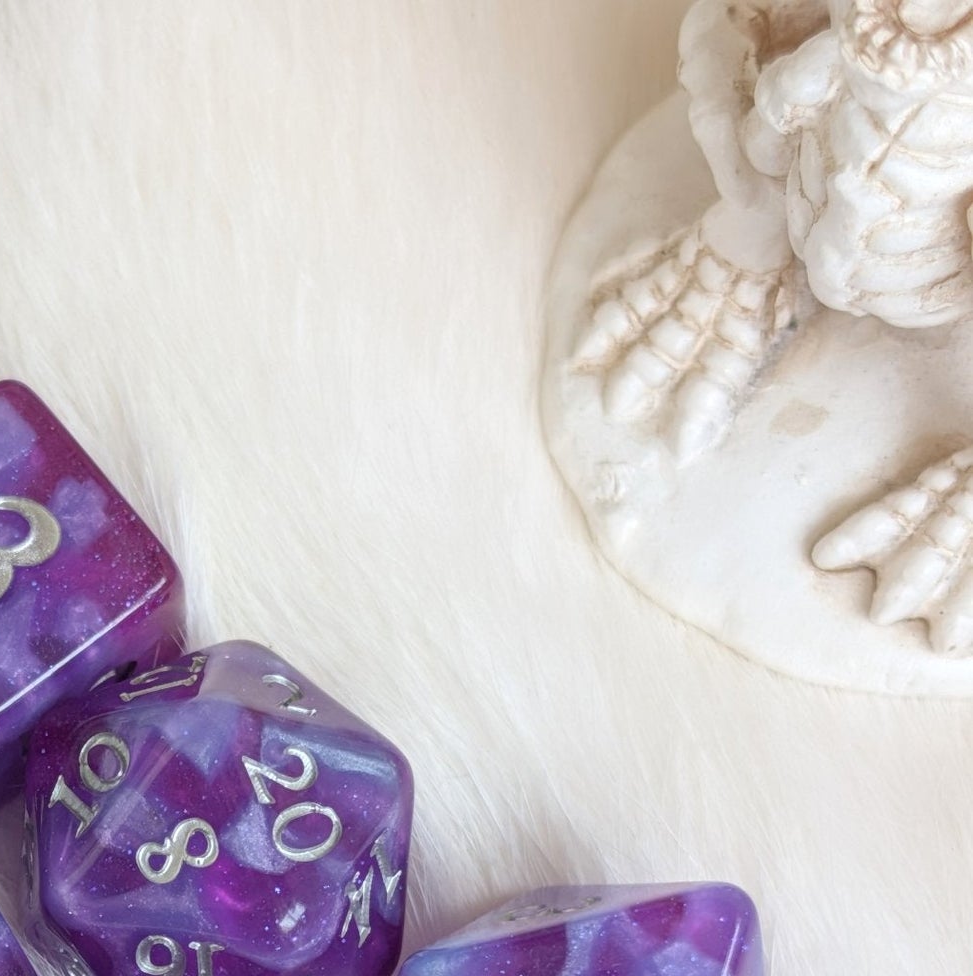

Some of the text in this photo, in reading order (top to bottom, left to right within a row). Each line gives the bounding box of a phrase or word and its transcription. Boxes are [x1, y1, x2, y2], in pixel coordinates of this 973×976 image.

[48, 731, 130, 839] 10
[241, 744, 342, 862] 20
[136, 817, 219, 884] 8
